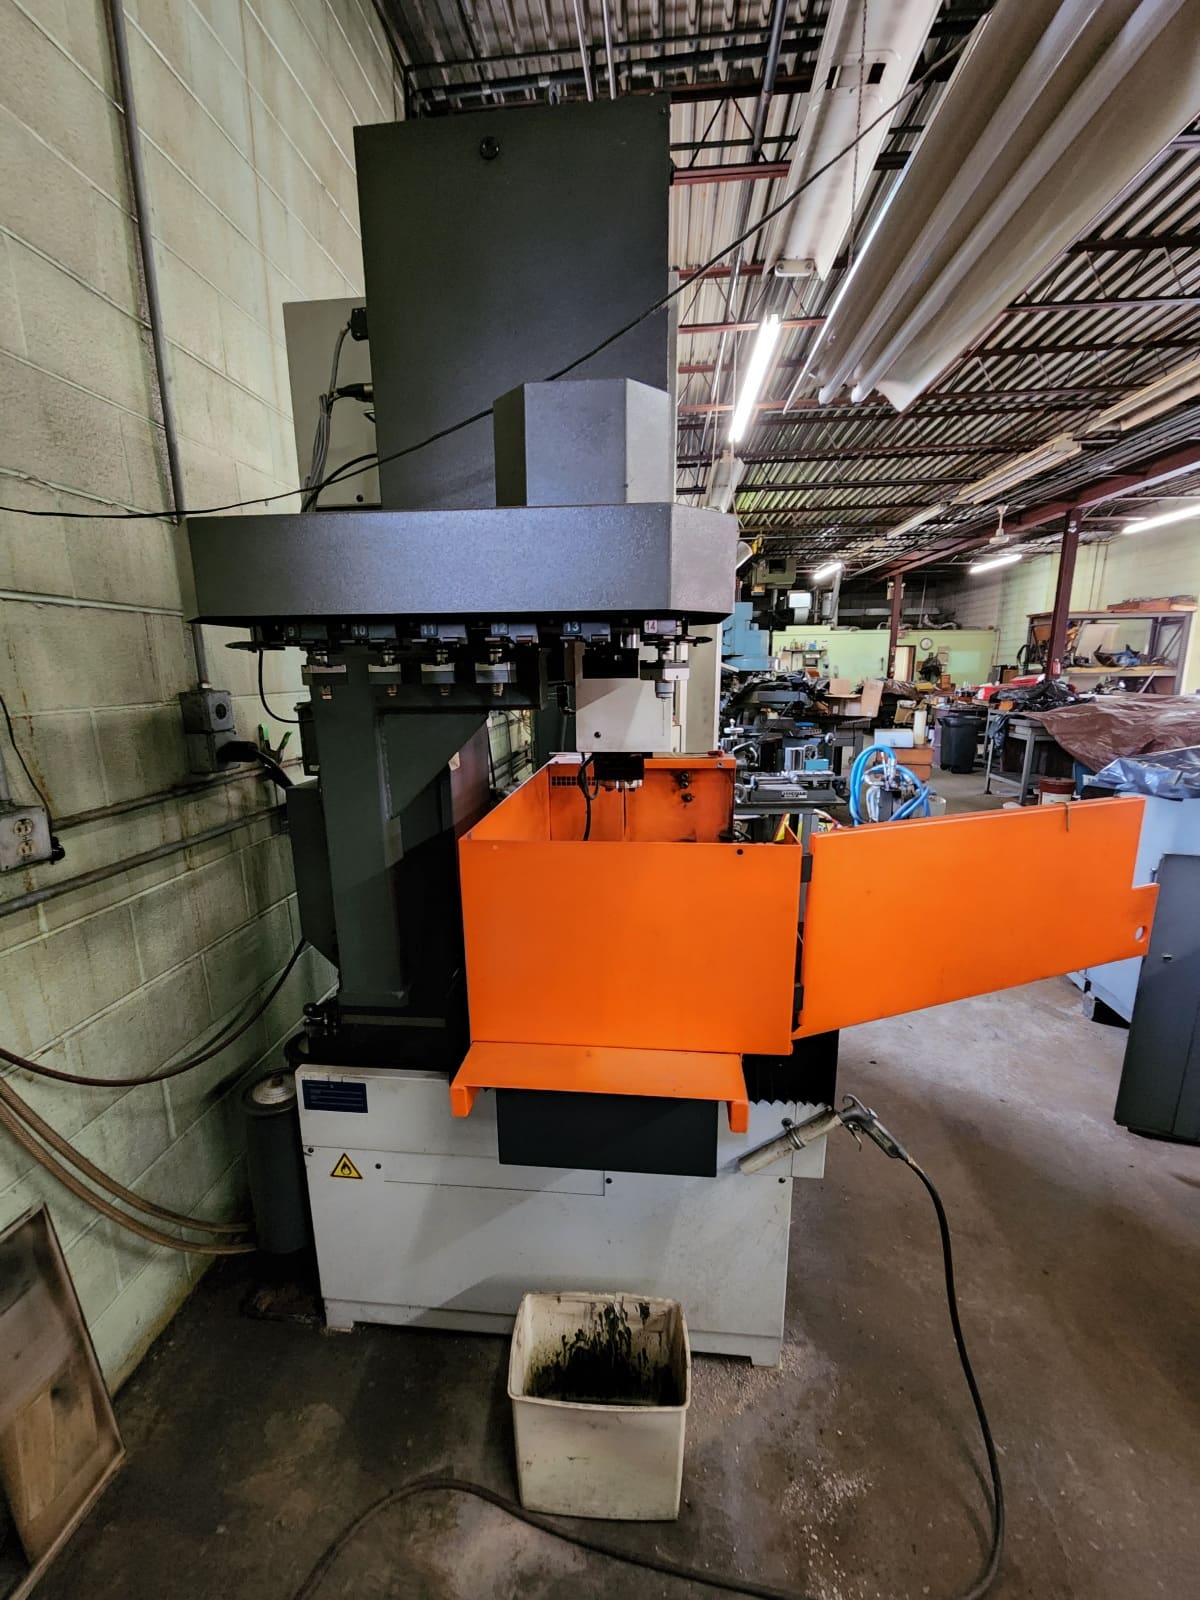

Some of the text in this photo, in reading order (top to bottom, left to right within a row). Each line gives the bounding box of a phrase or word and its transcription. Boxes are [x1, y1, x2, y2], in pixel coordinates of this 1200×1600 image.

[352, 626, 366, 636] 10
[421, 625, 434, 635] 11
[494, 623, 507, 633] 12
[565, 621, 579, 632] 13
[645, 621, 656, 631] 14
